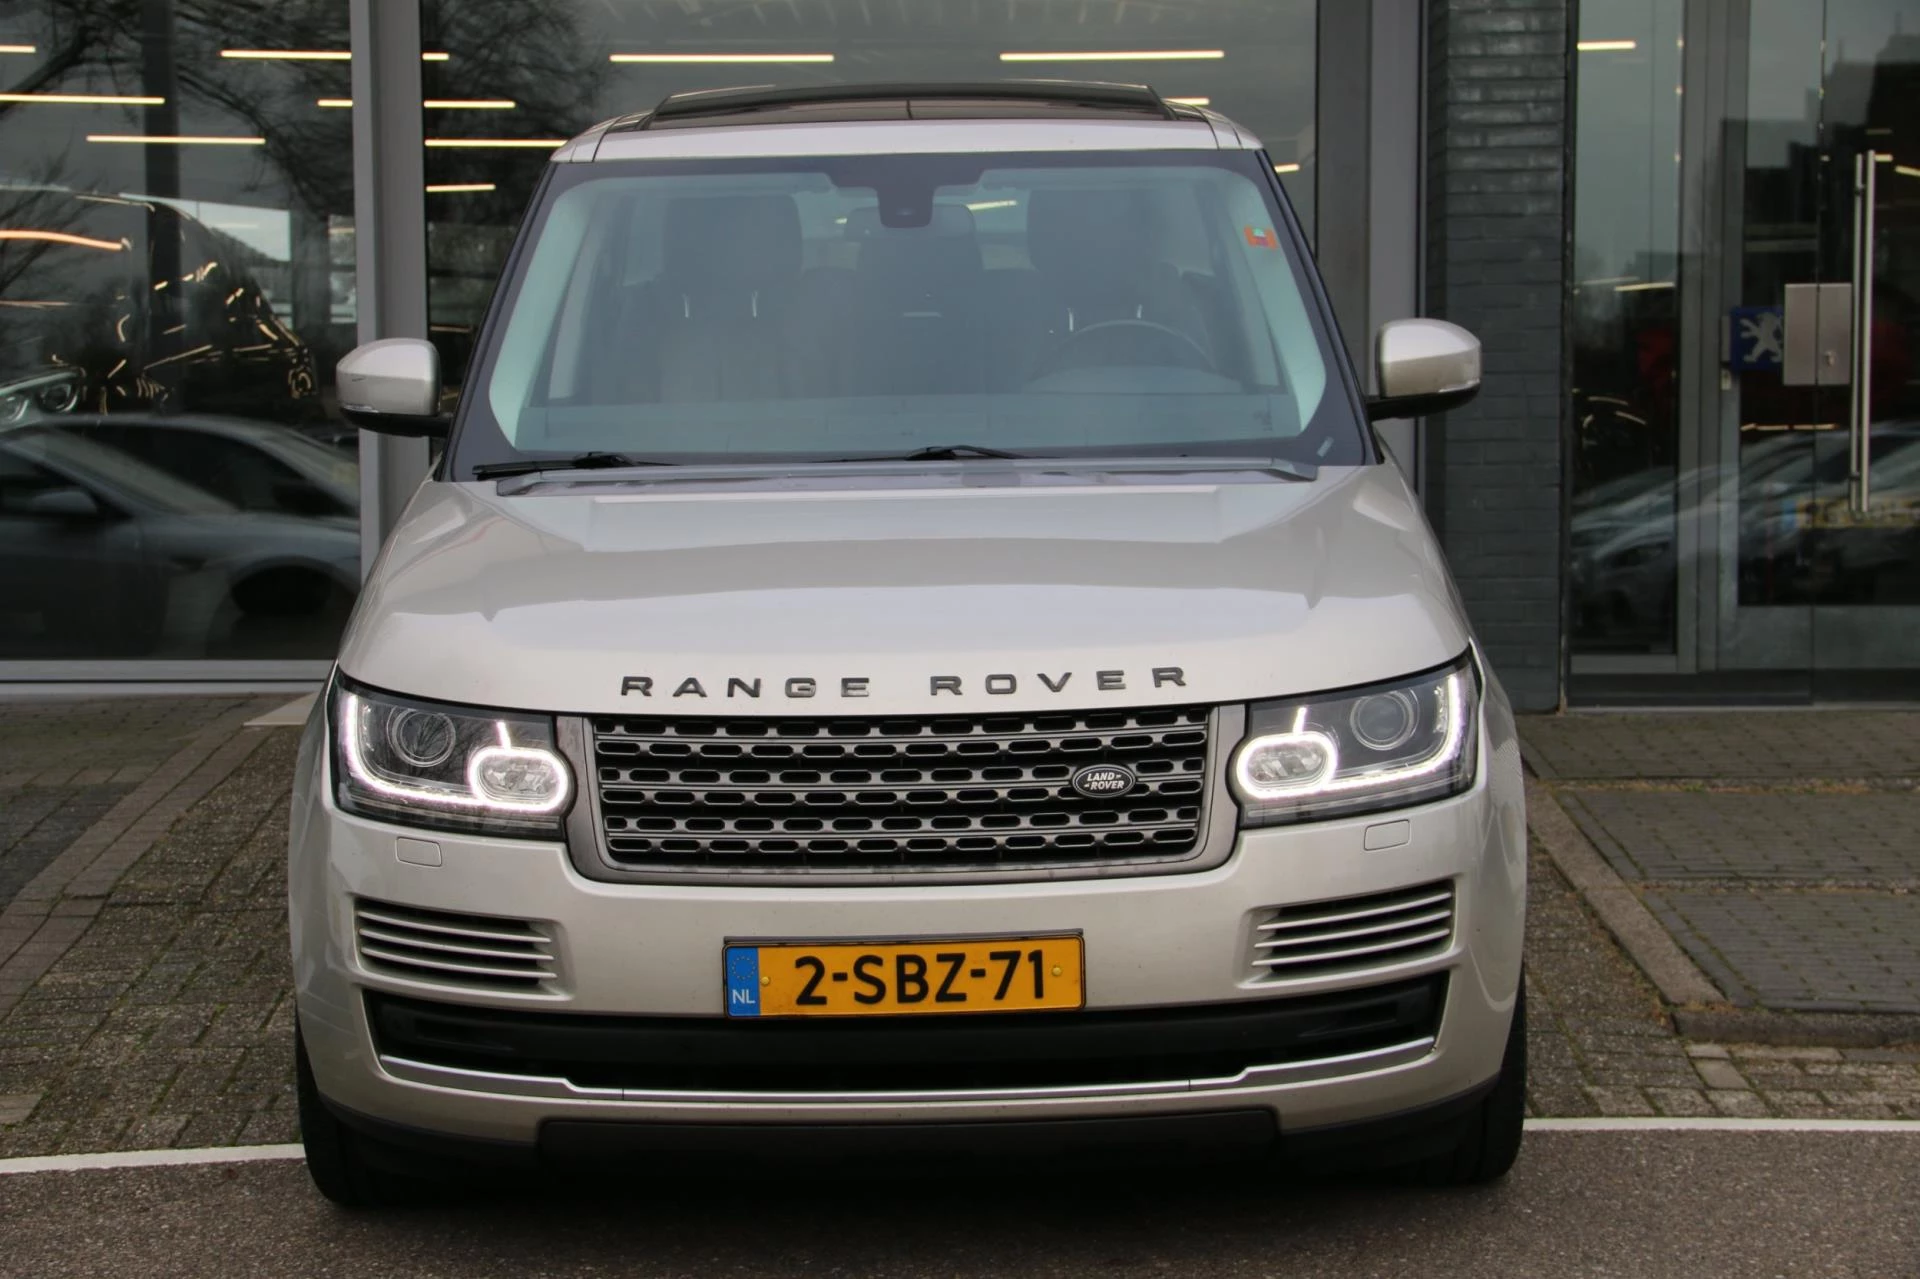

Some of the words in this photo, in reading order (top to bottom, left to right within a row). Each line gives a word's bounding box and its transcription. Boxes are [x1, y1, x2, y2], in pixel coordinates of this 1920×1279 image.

[621, 677, 870, 698] RANGE
[930, 667, 1186, 696] ROVER
[794, 949, 1045, 1006] 2-SBZ-71
[732, 989, 756, 1005] NL
